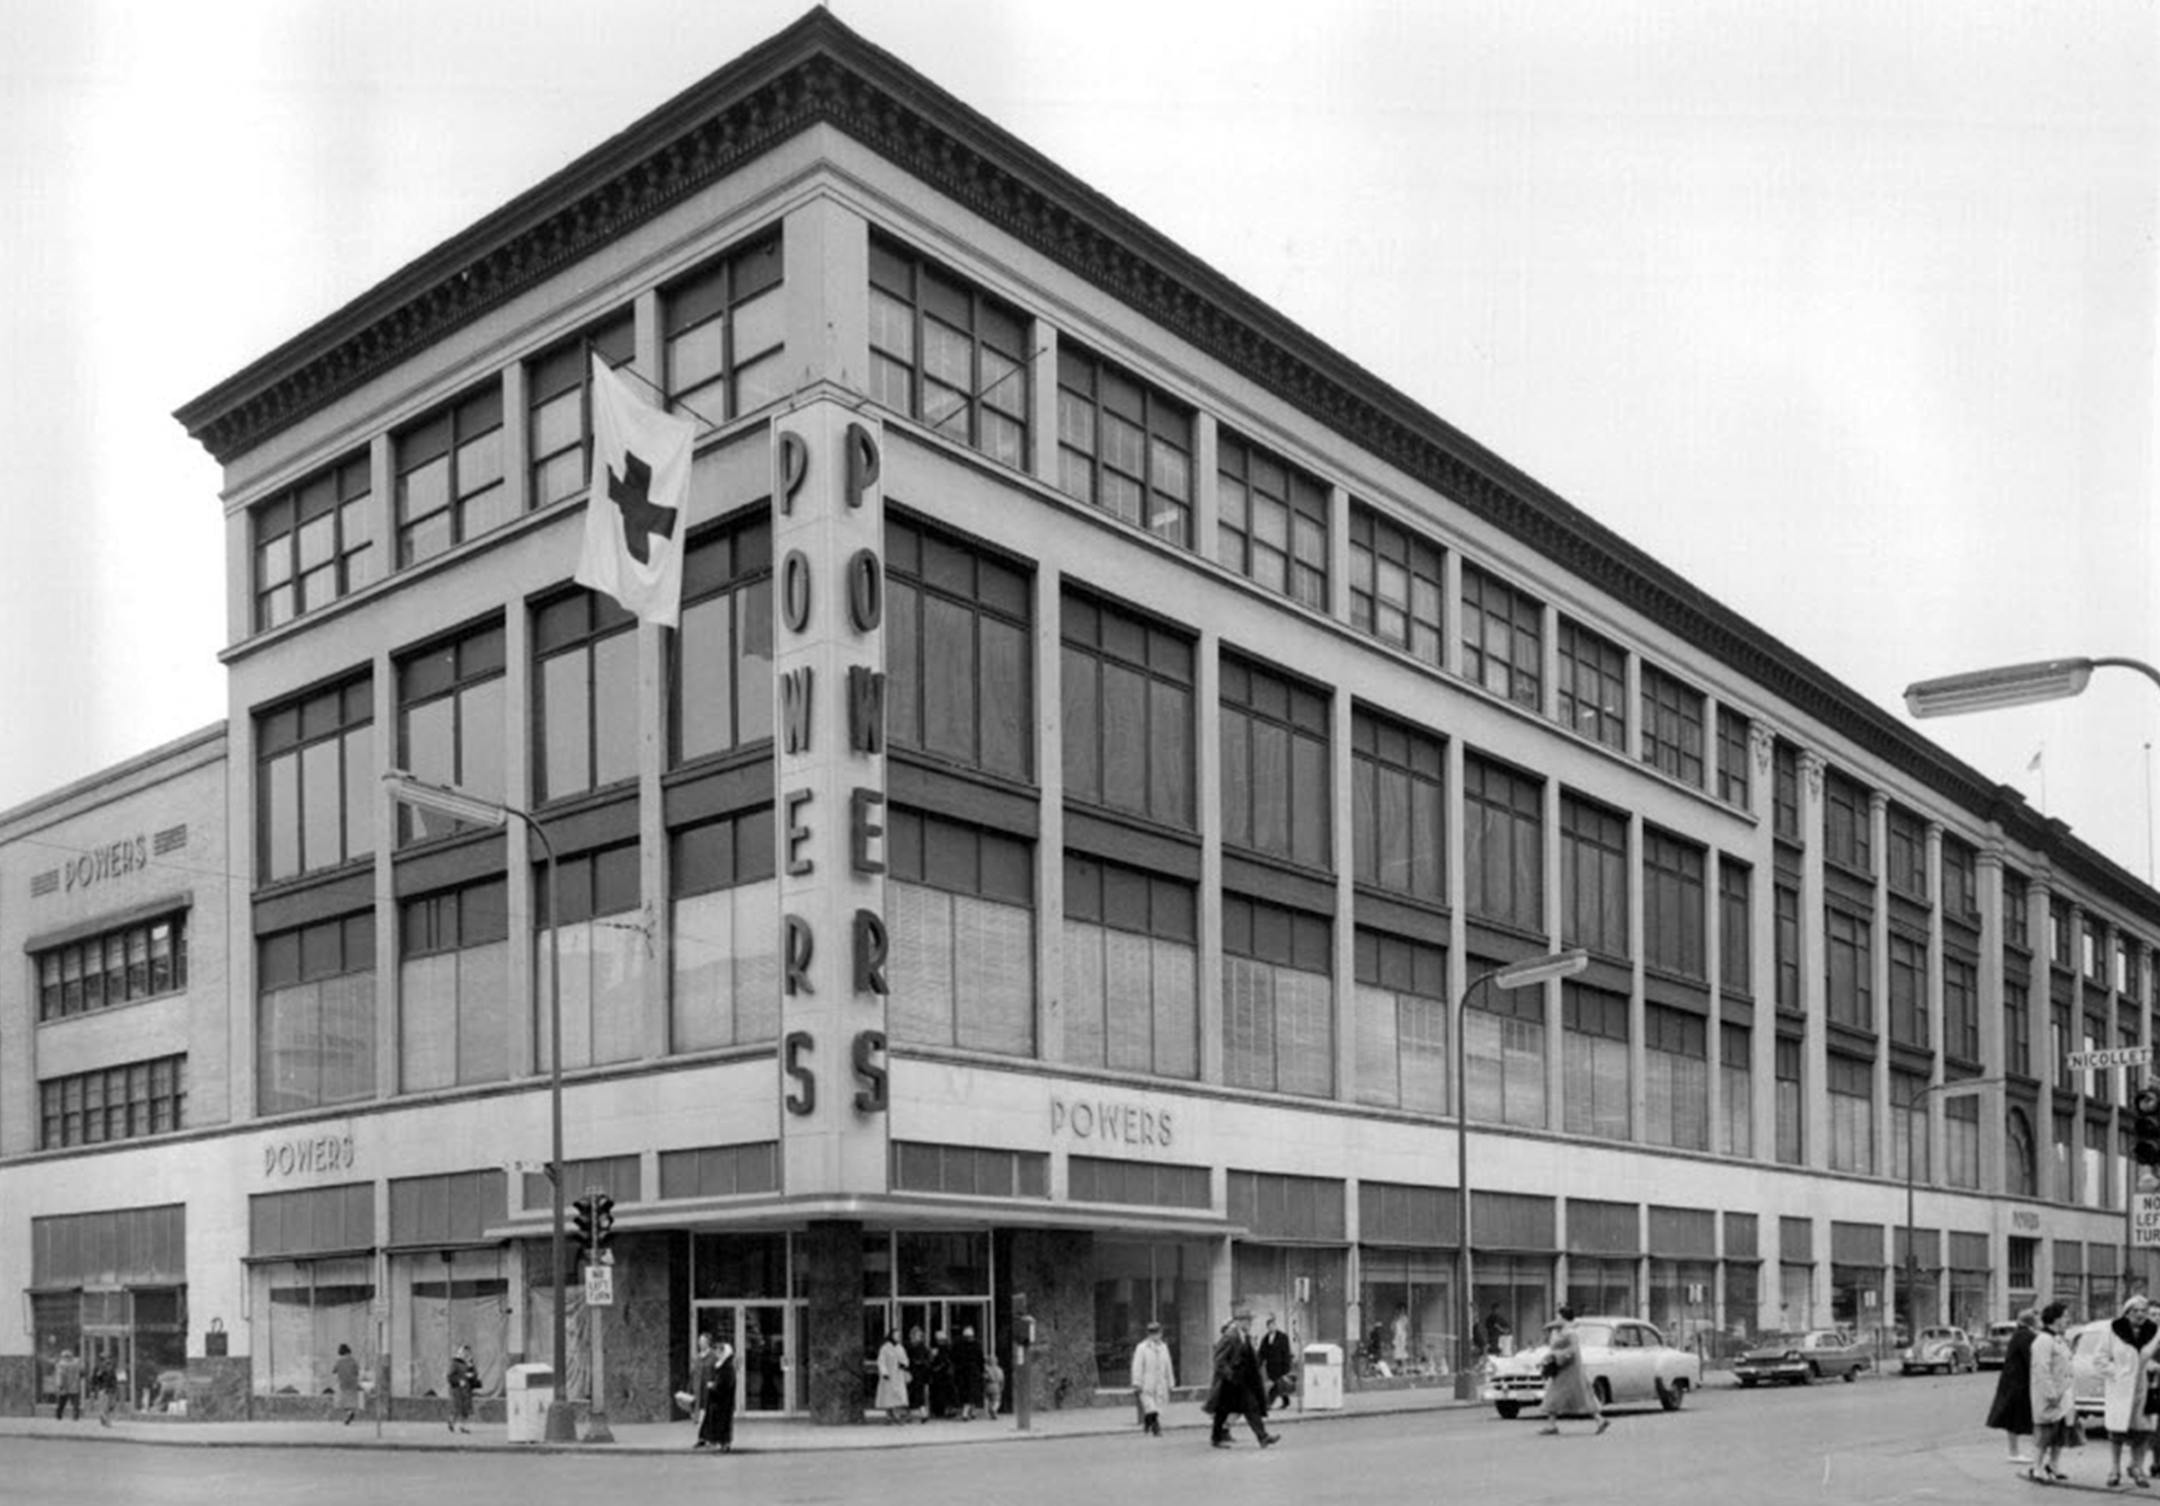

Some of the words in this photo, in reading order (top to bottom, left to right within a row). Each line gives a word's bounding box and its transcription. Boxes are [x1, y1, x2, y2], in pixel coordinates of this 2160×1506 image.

[779, 430, 815, 1116] POWERS
[846, 422, 889, 1113] POWERS
[66, 834, 147, 893] POWERS
[2072, 1049, 2147, 1067] NICOLLET
[1050, 1099, 1172, 1147] POWERS
[264, 1136, 355, 1178] POWERS
[2143, 1196, 2160, 1210] NO
